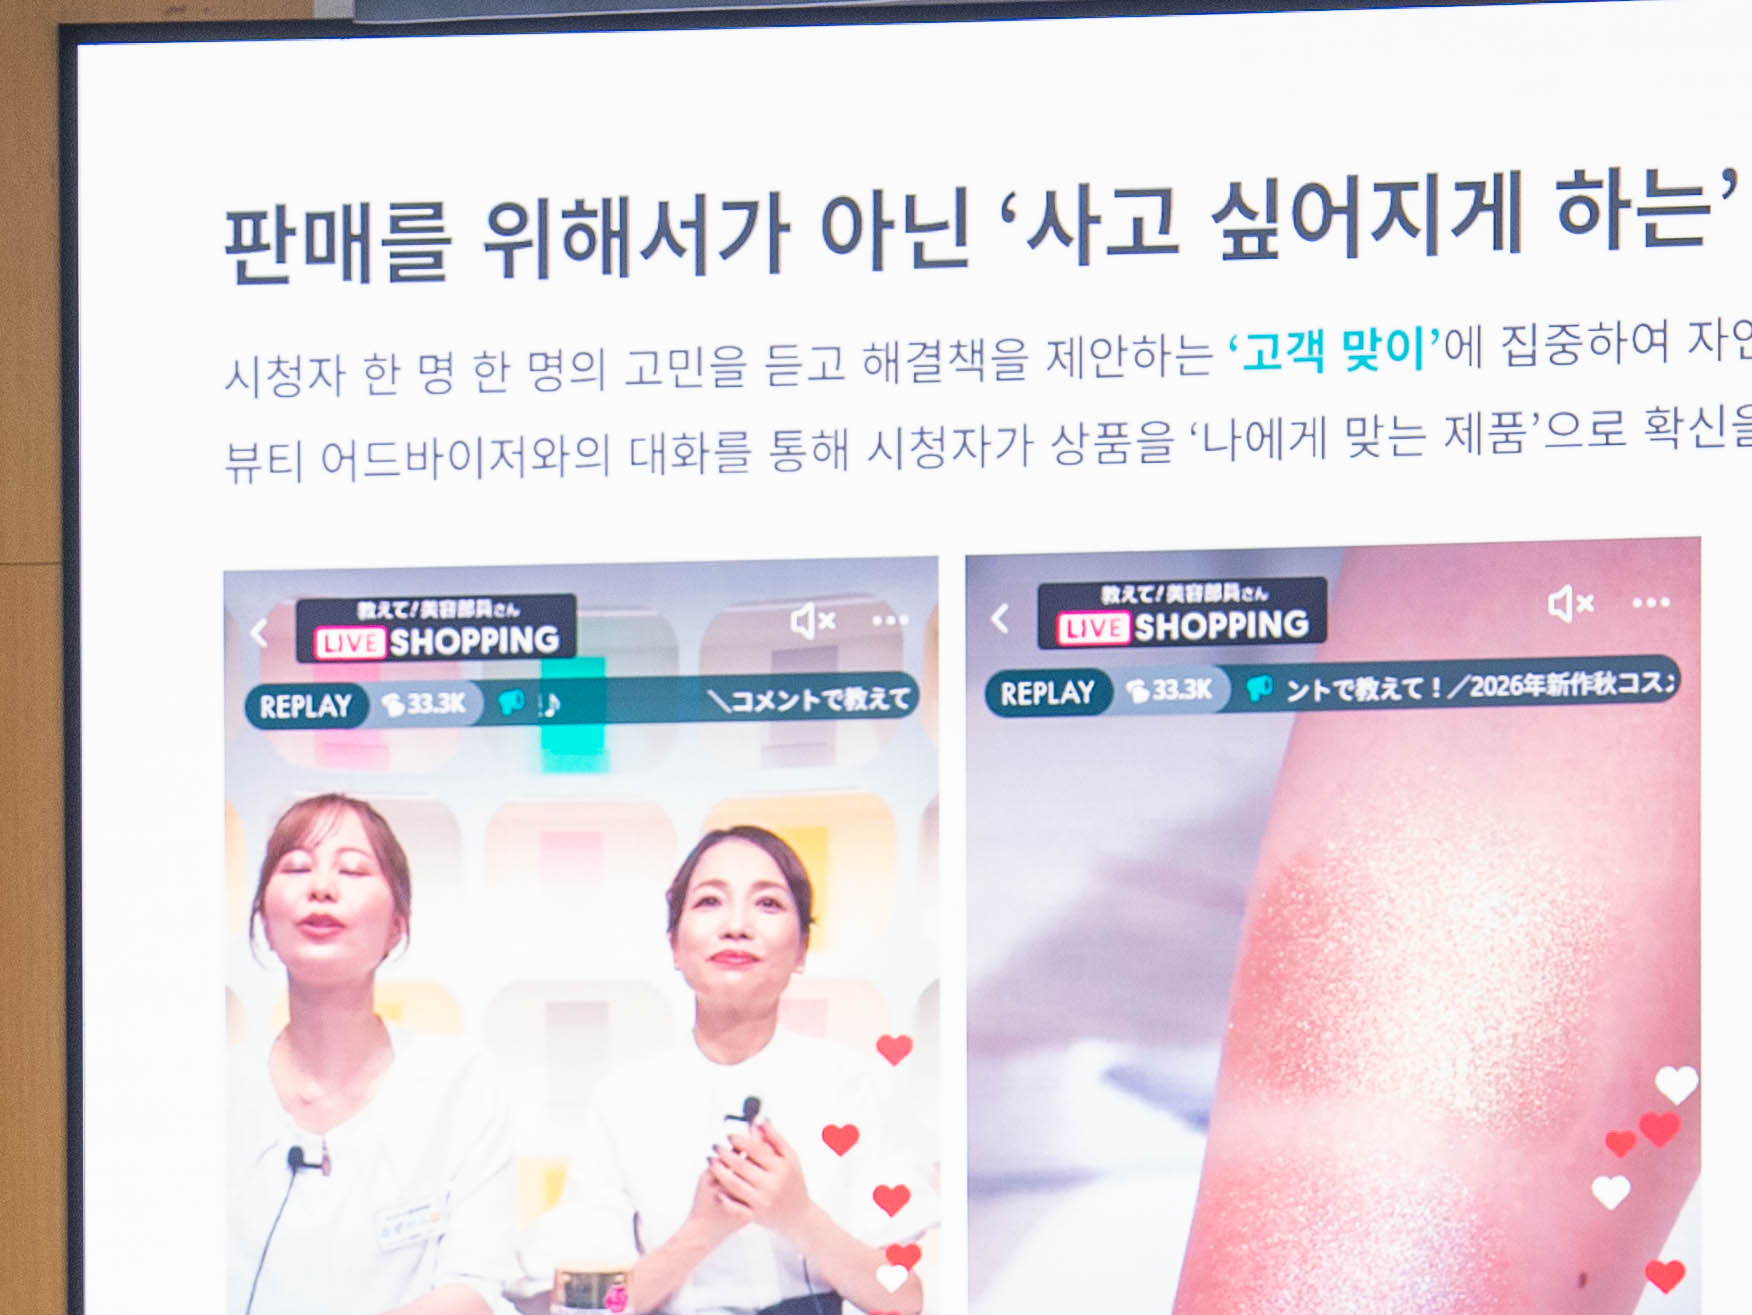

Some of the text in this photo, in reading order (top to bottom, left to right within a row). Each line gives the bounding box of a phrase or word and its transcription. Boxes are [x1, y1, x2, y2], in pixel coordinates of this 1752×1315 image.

[225, 202, 452, 285] 판매를
[484, 192, 790, 280] 위해서가
[822, 187, 968, 271] 아닌
[1212, 170, 1521, 261] 싶어지게
[225, 355, 345, 398] 시청자
[364, 353, 400, 395] 한
[420, 352, 452, 394] 명
[474, 351, 510, 393] 한
[530, 348, 603, 392] 명의
[626, 346, 746, 388] 고민을
[766, 345, 844, 386] 듣고
[864, 339, 1028, 384] 해결책을
[1047, 334, 1213, 379] 제안하는
[1503, 319, 1667, 367] 집중하여
[226, 440, 300, 484] 뷰티
[322, 434, 608, 482] 어드바이저와의
[631, 432, 751, 475] 대화를
[770, 429, 847, 472] 통해
[868, 424, 1034, 470] 시청자가
[1052, 421, 1174, 465] 상품을
[1347, 414, 1426, 458] 맞는
[324, 625, 561, 656] LIVE SHOPPING
[1067, 609, 1310, 641] LIVE SHOPPING
[408, 691, 467, 715] 33.3K
[1000, 679, 1095, 706] REPLAY
[1152, 678, 1213, 701] 33.3K
[259, 693, 352, 719] REPLAY
